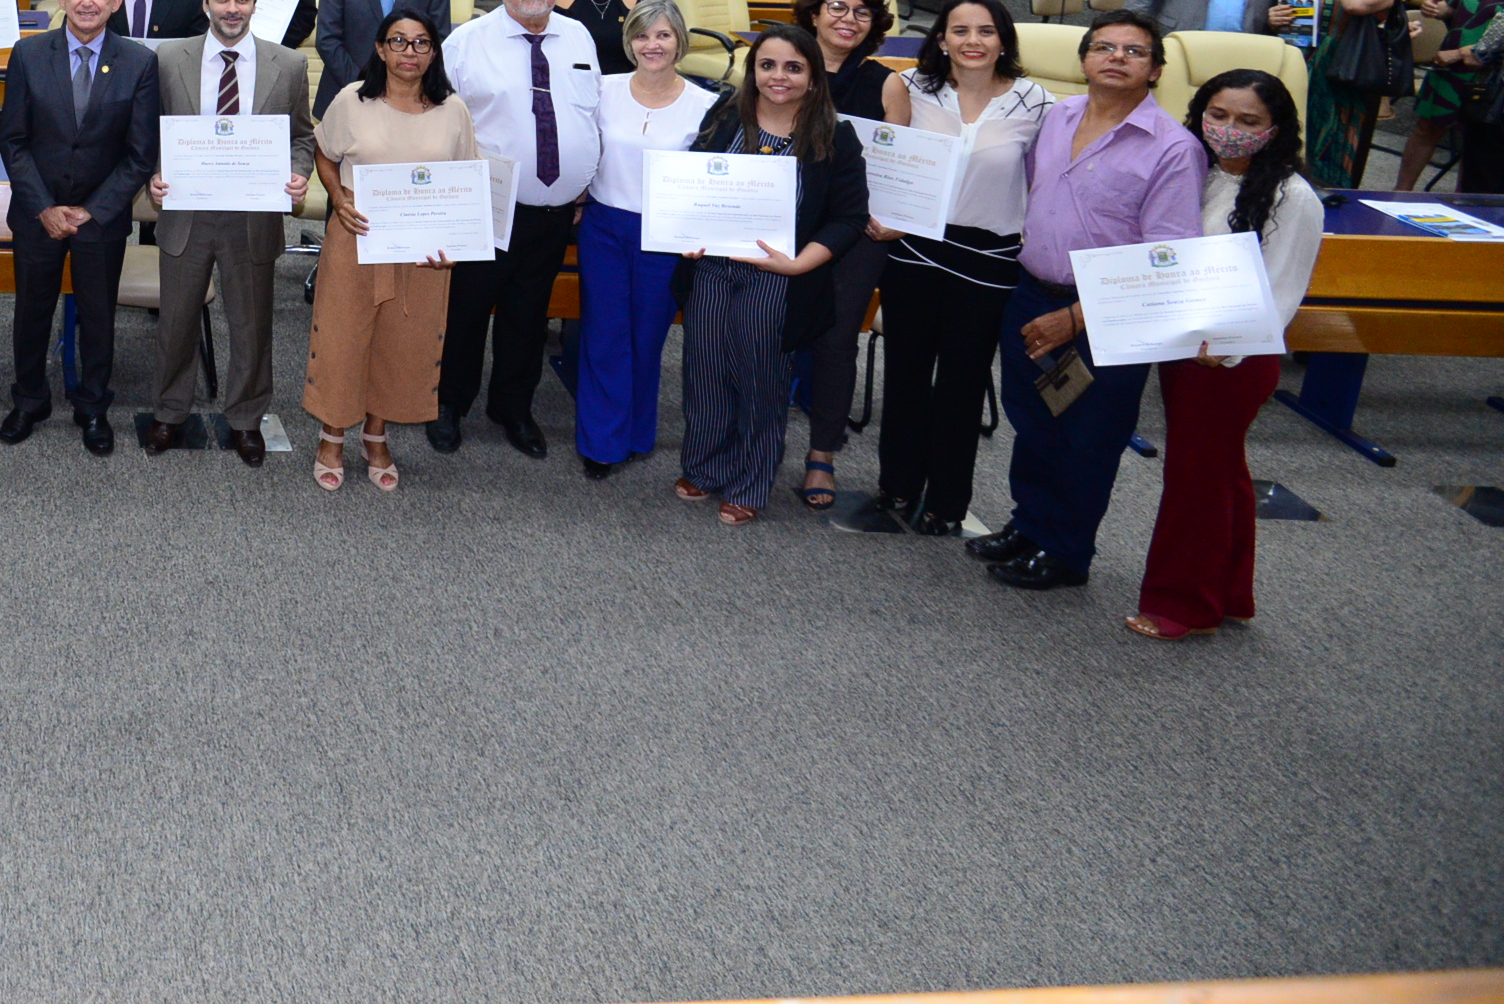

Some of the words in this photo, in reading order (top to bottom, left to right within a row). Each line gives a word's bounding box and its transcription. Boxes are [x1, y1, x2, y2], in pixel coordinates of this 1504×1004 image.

[1100, 276, 1139, 285] Diploma
[1156, 271, 1186, 279] Honra
[1204, 264, 1238, 275] Mérito
